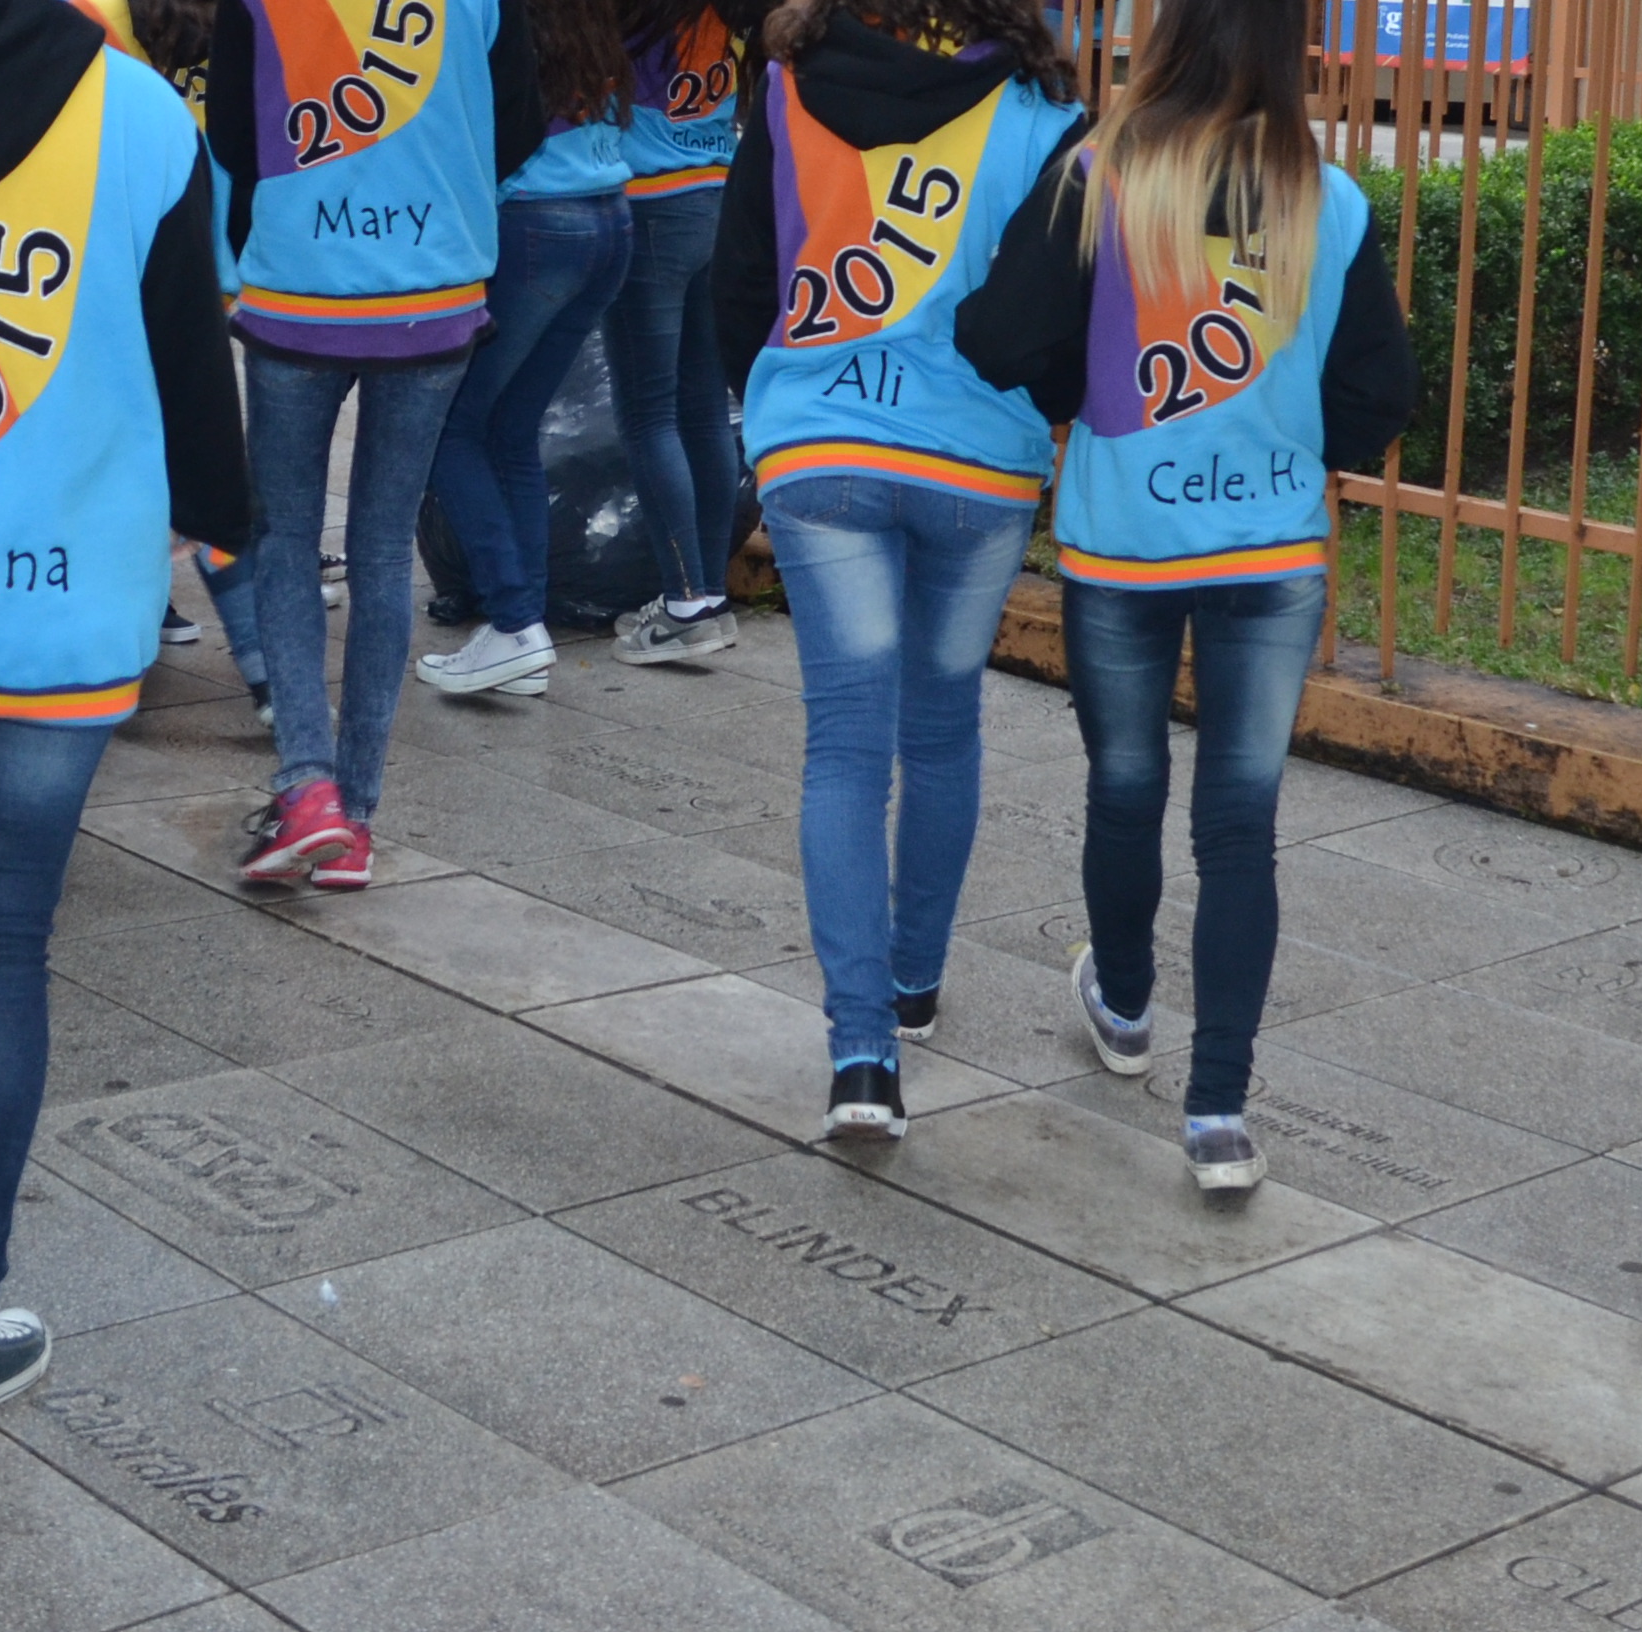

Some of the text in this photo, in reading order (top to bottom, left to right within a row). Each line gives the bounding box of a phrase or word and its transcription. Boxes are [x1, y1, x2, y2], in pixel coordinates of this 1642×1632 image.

[314, 198, 432, 246] Mary
[787, 154, 962, 343] 2015
[822, 353, 904, 408] Ali
[679, 1186, 994, 1328] BLINDEX
[39, 1386, 272, 1525] Cabrales
